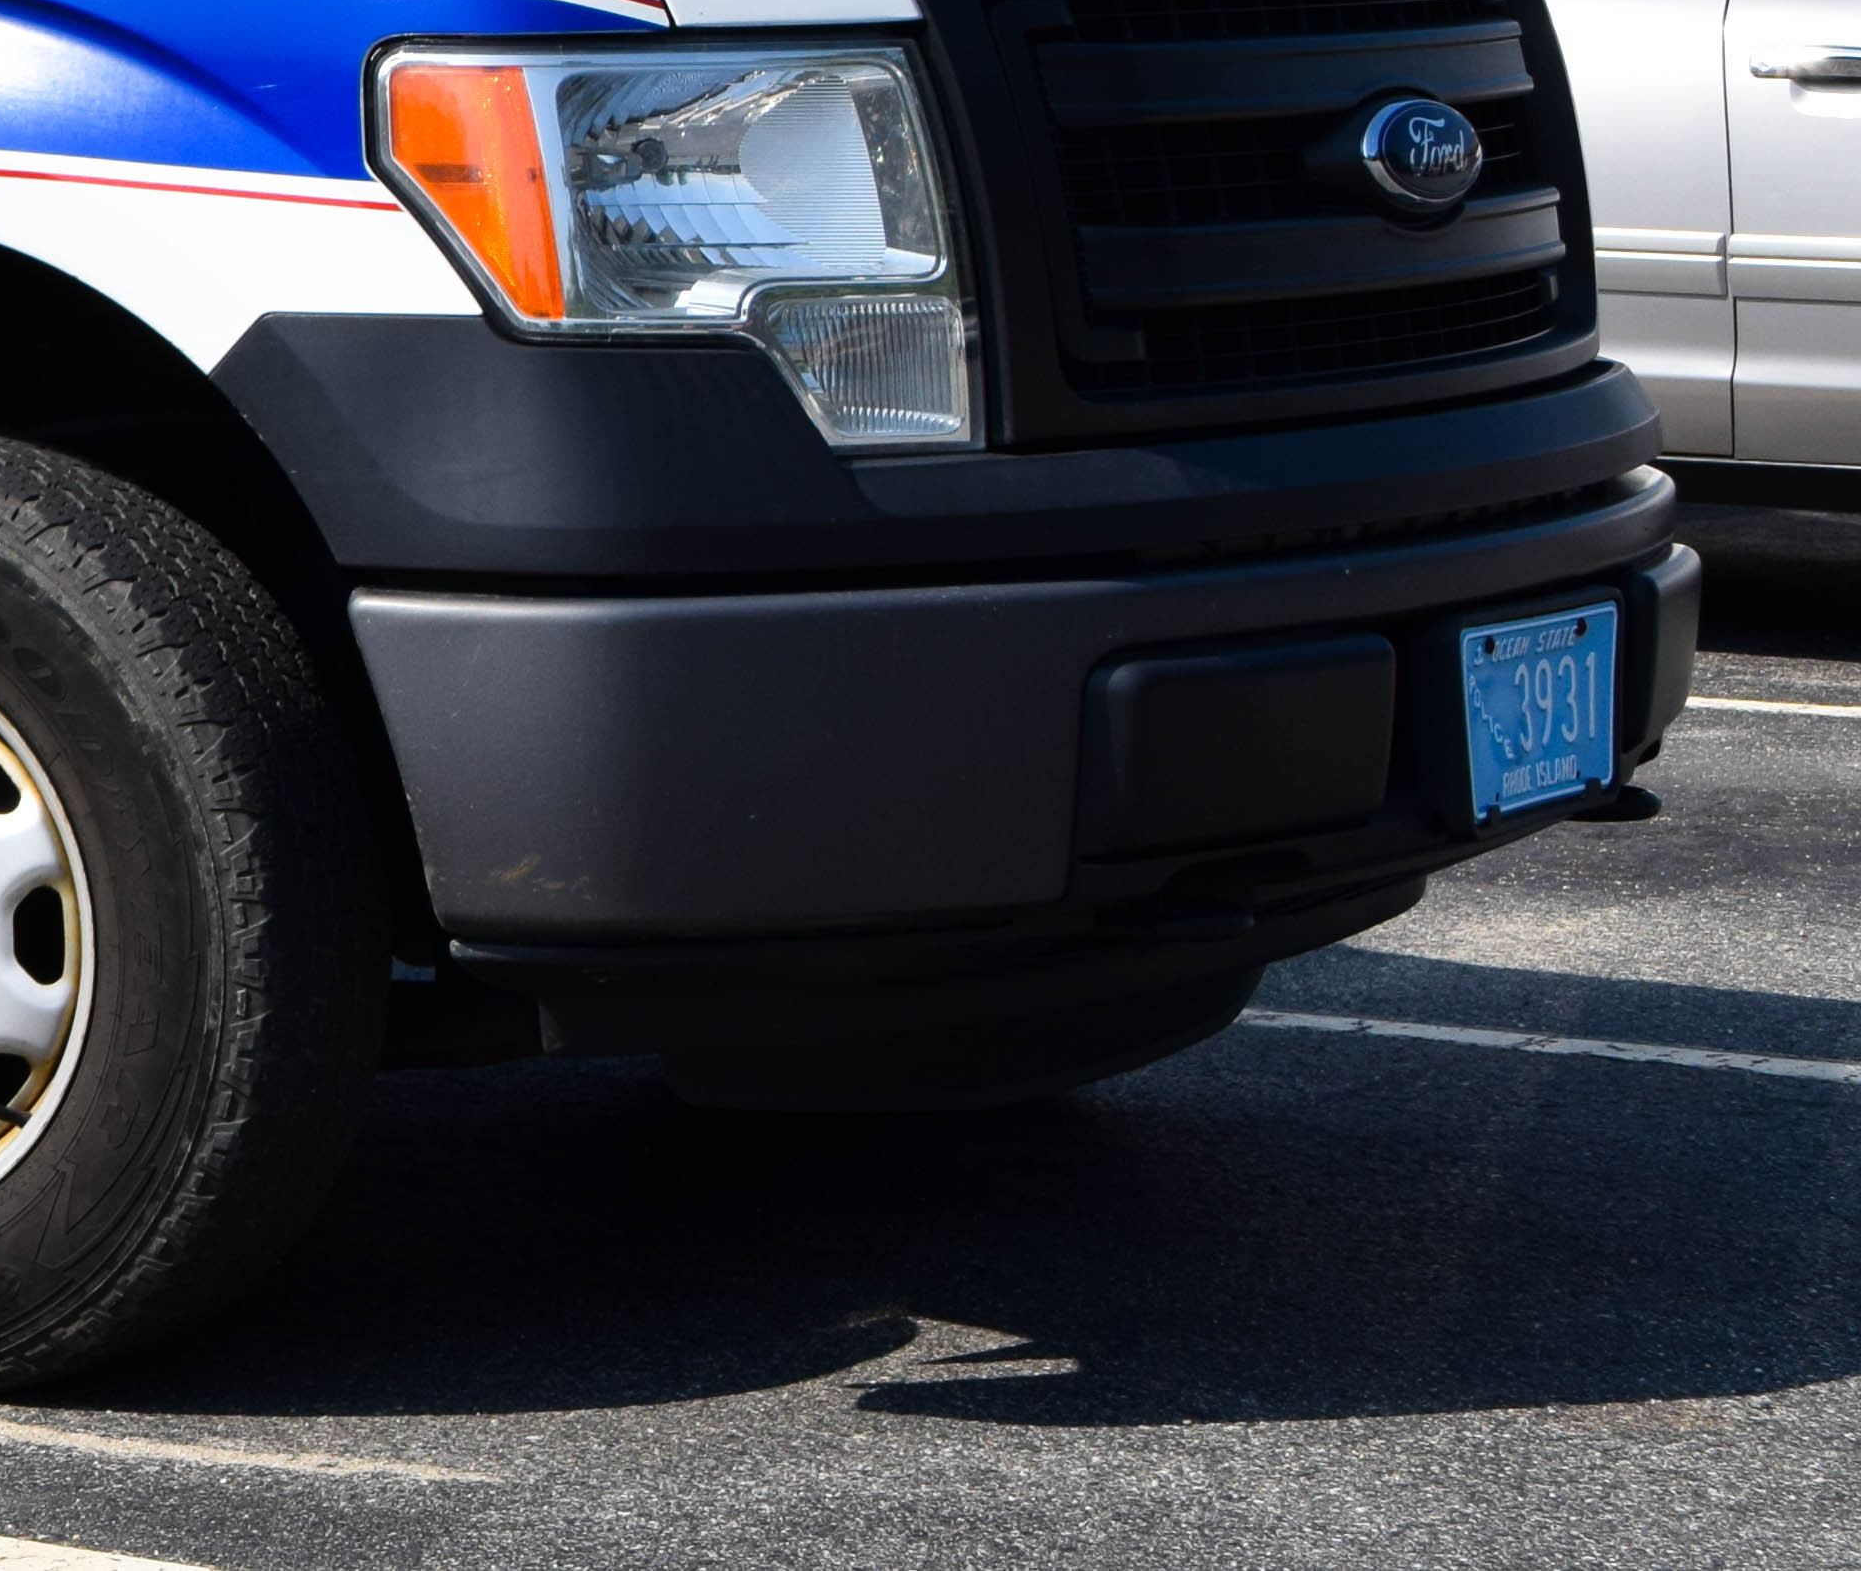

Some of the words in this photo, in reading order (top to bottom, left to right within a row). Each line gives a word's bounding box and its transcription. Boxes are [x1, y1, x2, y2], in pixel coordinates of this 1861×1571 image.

[1409, 116, 1467, 178] Ford
[1492, 636, 1529, 663] OCEAN
[1536, 625, 1578, 654] STATE
[1468, 674, 1516, 760] POLICE
[1514, 651, 1597, 753] 3931
[1502, 765, 1533, 798] RHODE
[1536, 754, 1578, 787] ISLAND
